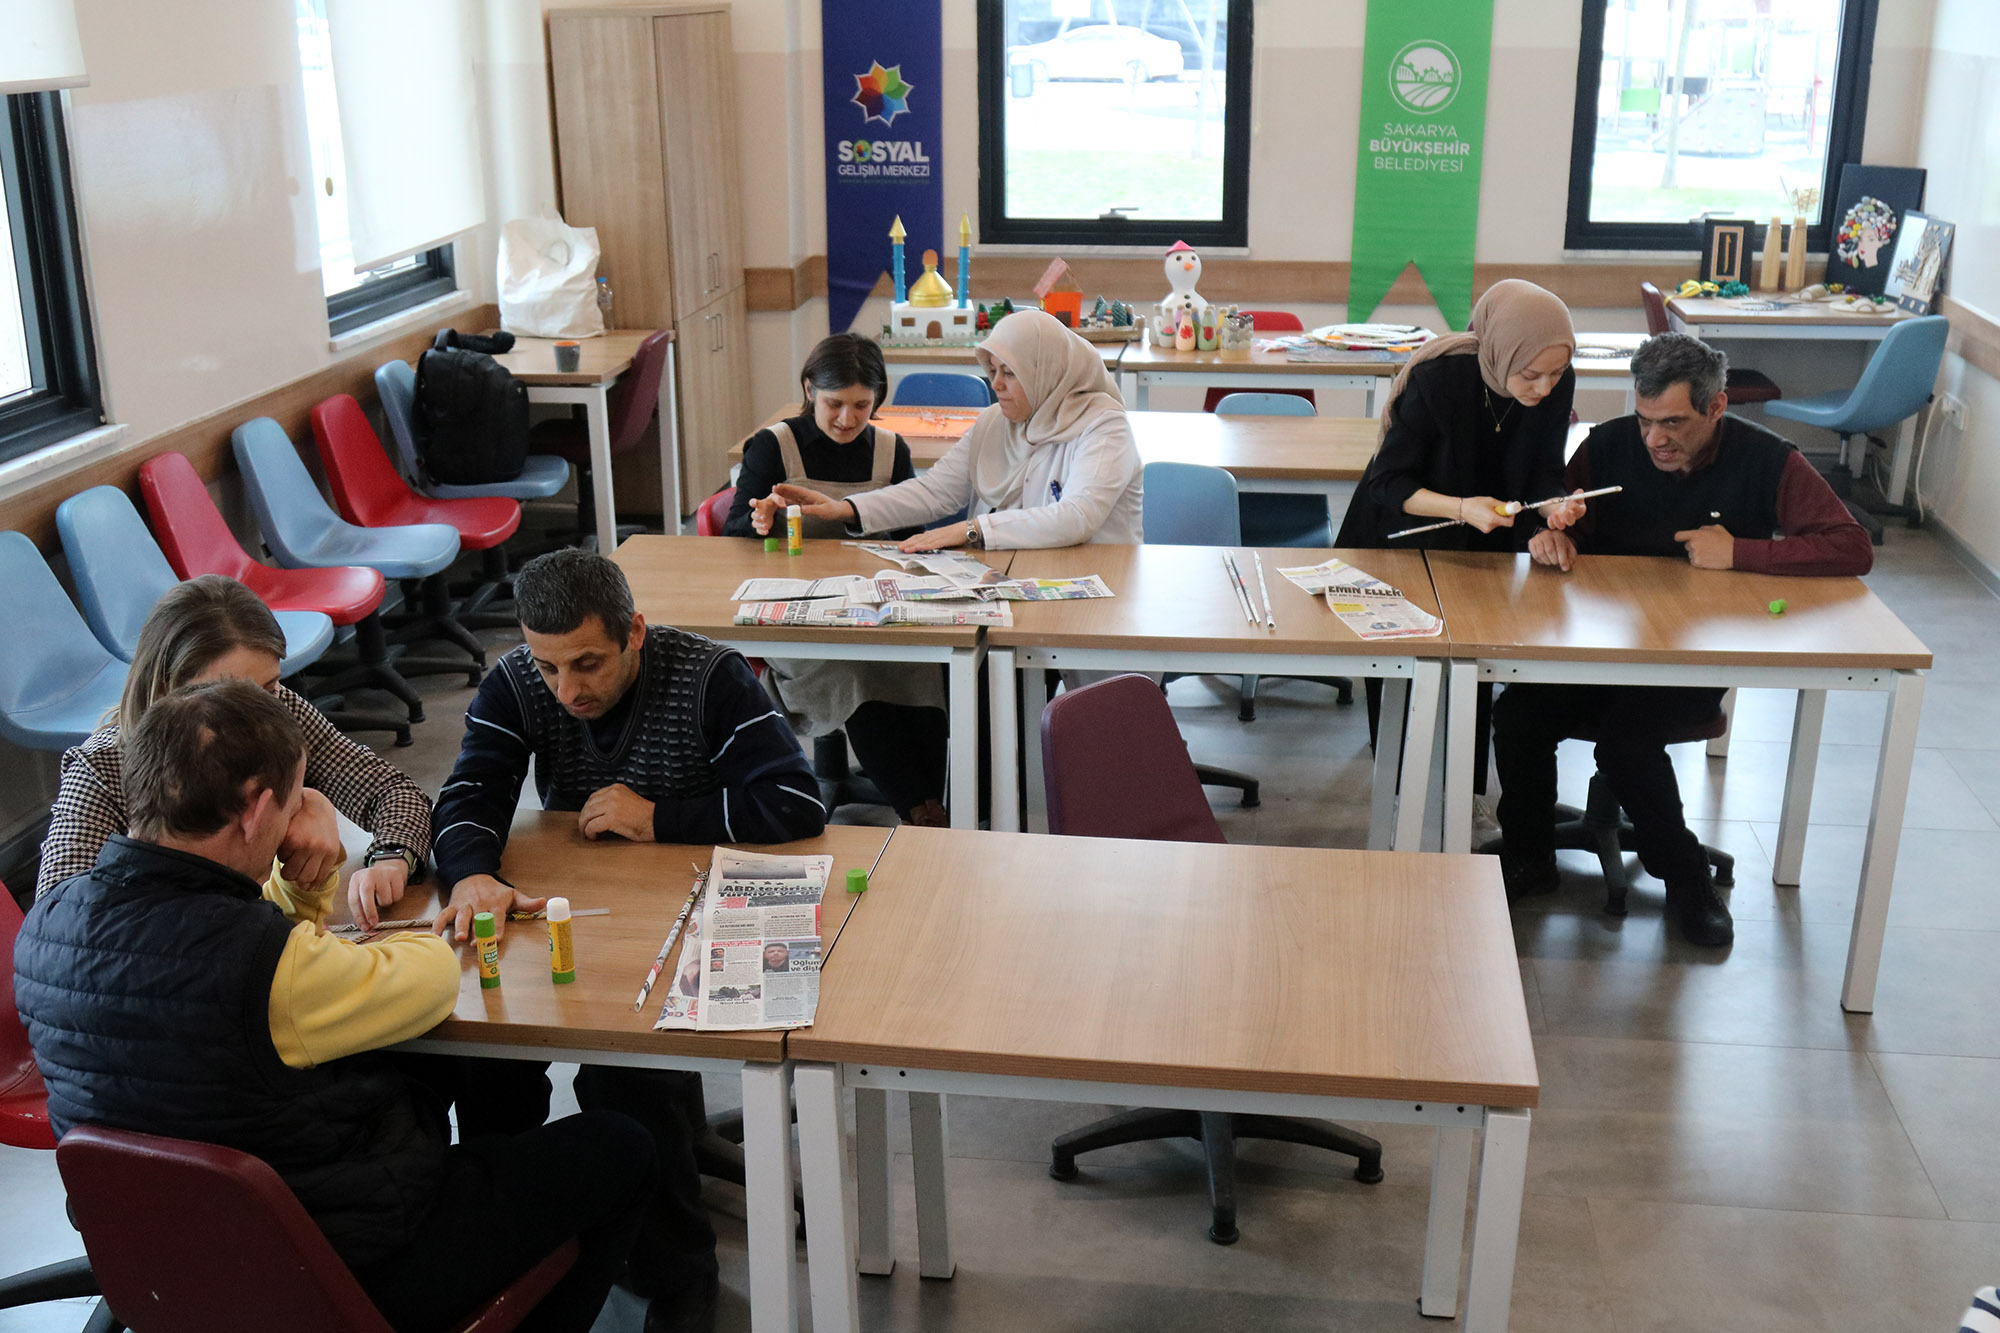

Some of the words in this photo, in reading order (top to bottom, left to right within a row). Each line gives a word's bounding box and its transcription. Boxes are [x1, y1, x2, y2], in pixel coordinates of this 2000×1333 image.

[1384, 123, 1457, 137] SAKARYA
[838, 139, 929, 163] SOSYAL
[1370, 137, 1470, 156] BÜYÜKŞEHİR
[838, 163, 880, 178] GELİŞİM
[882, 163, 930, 177] MERKEZİ
[1374, 156, 1463, 172] BELEDİYESİ
